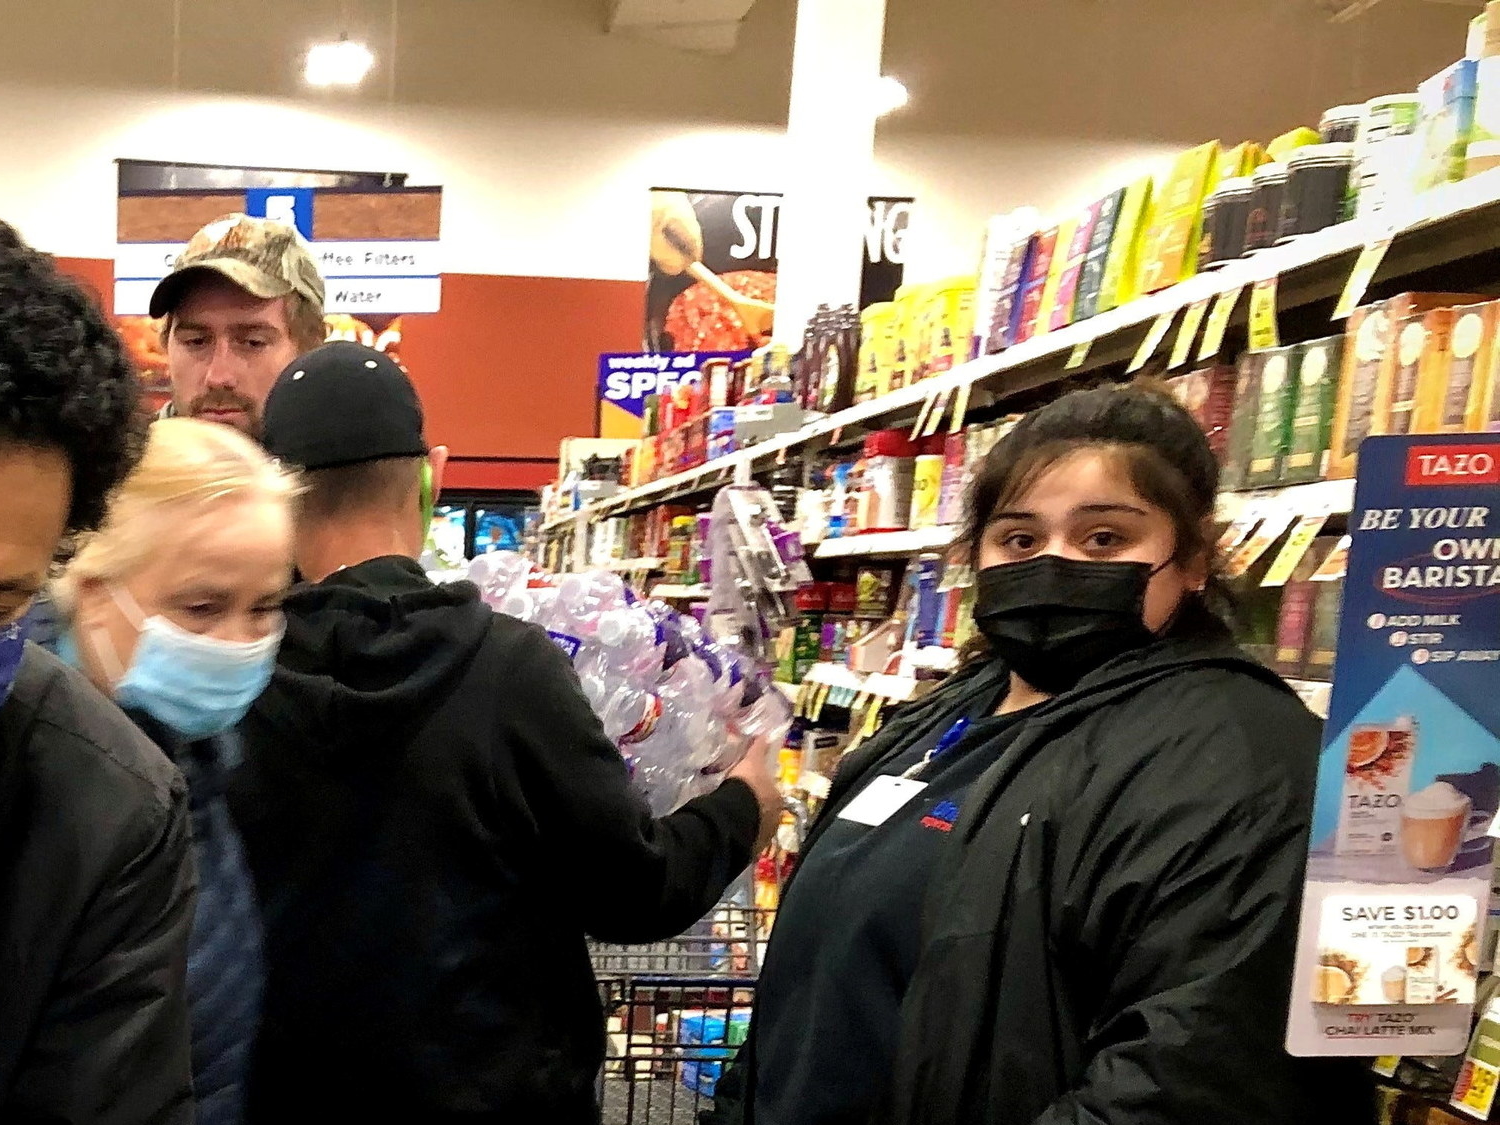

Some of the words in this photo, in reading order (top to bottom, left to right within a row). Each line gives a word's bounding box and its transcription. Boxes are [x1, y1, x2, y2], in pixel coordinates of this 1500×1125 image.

[1418, 453, 1495, 477] TAZO
[1358, 508, 1403, 531] BE
[1409, 506, 1490, 529] YOUR
[1347, 793, 1403, 809] TAZO
[1341, 906, 1396, 922] SAVE
[1403, 904, 1460, 921] $1.00
[1364, 1026, 1406, 1036] LATTE
